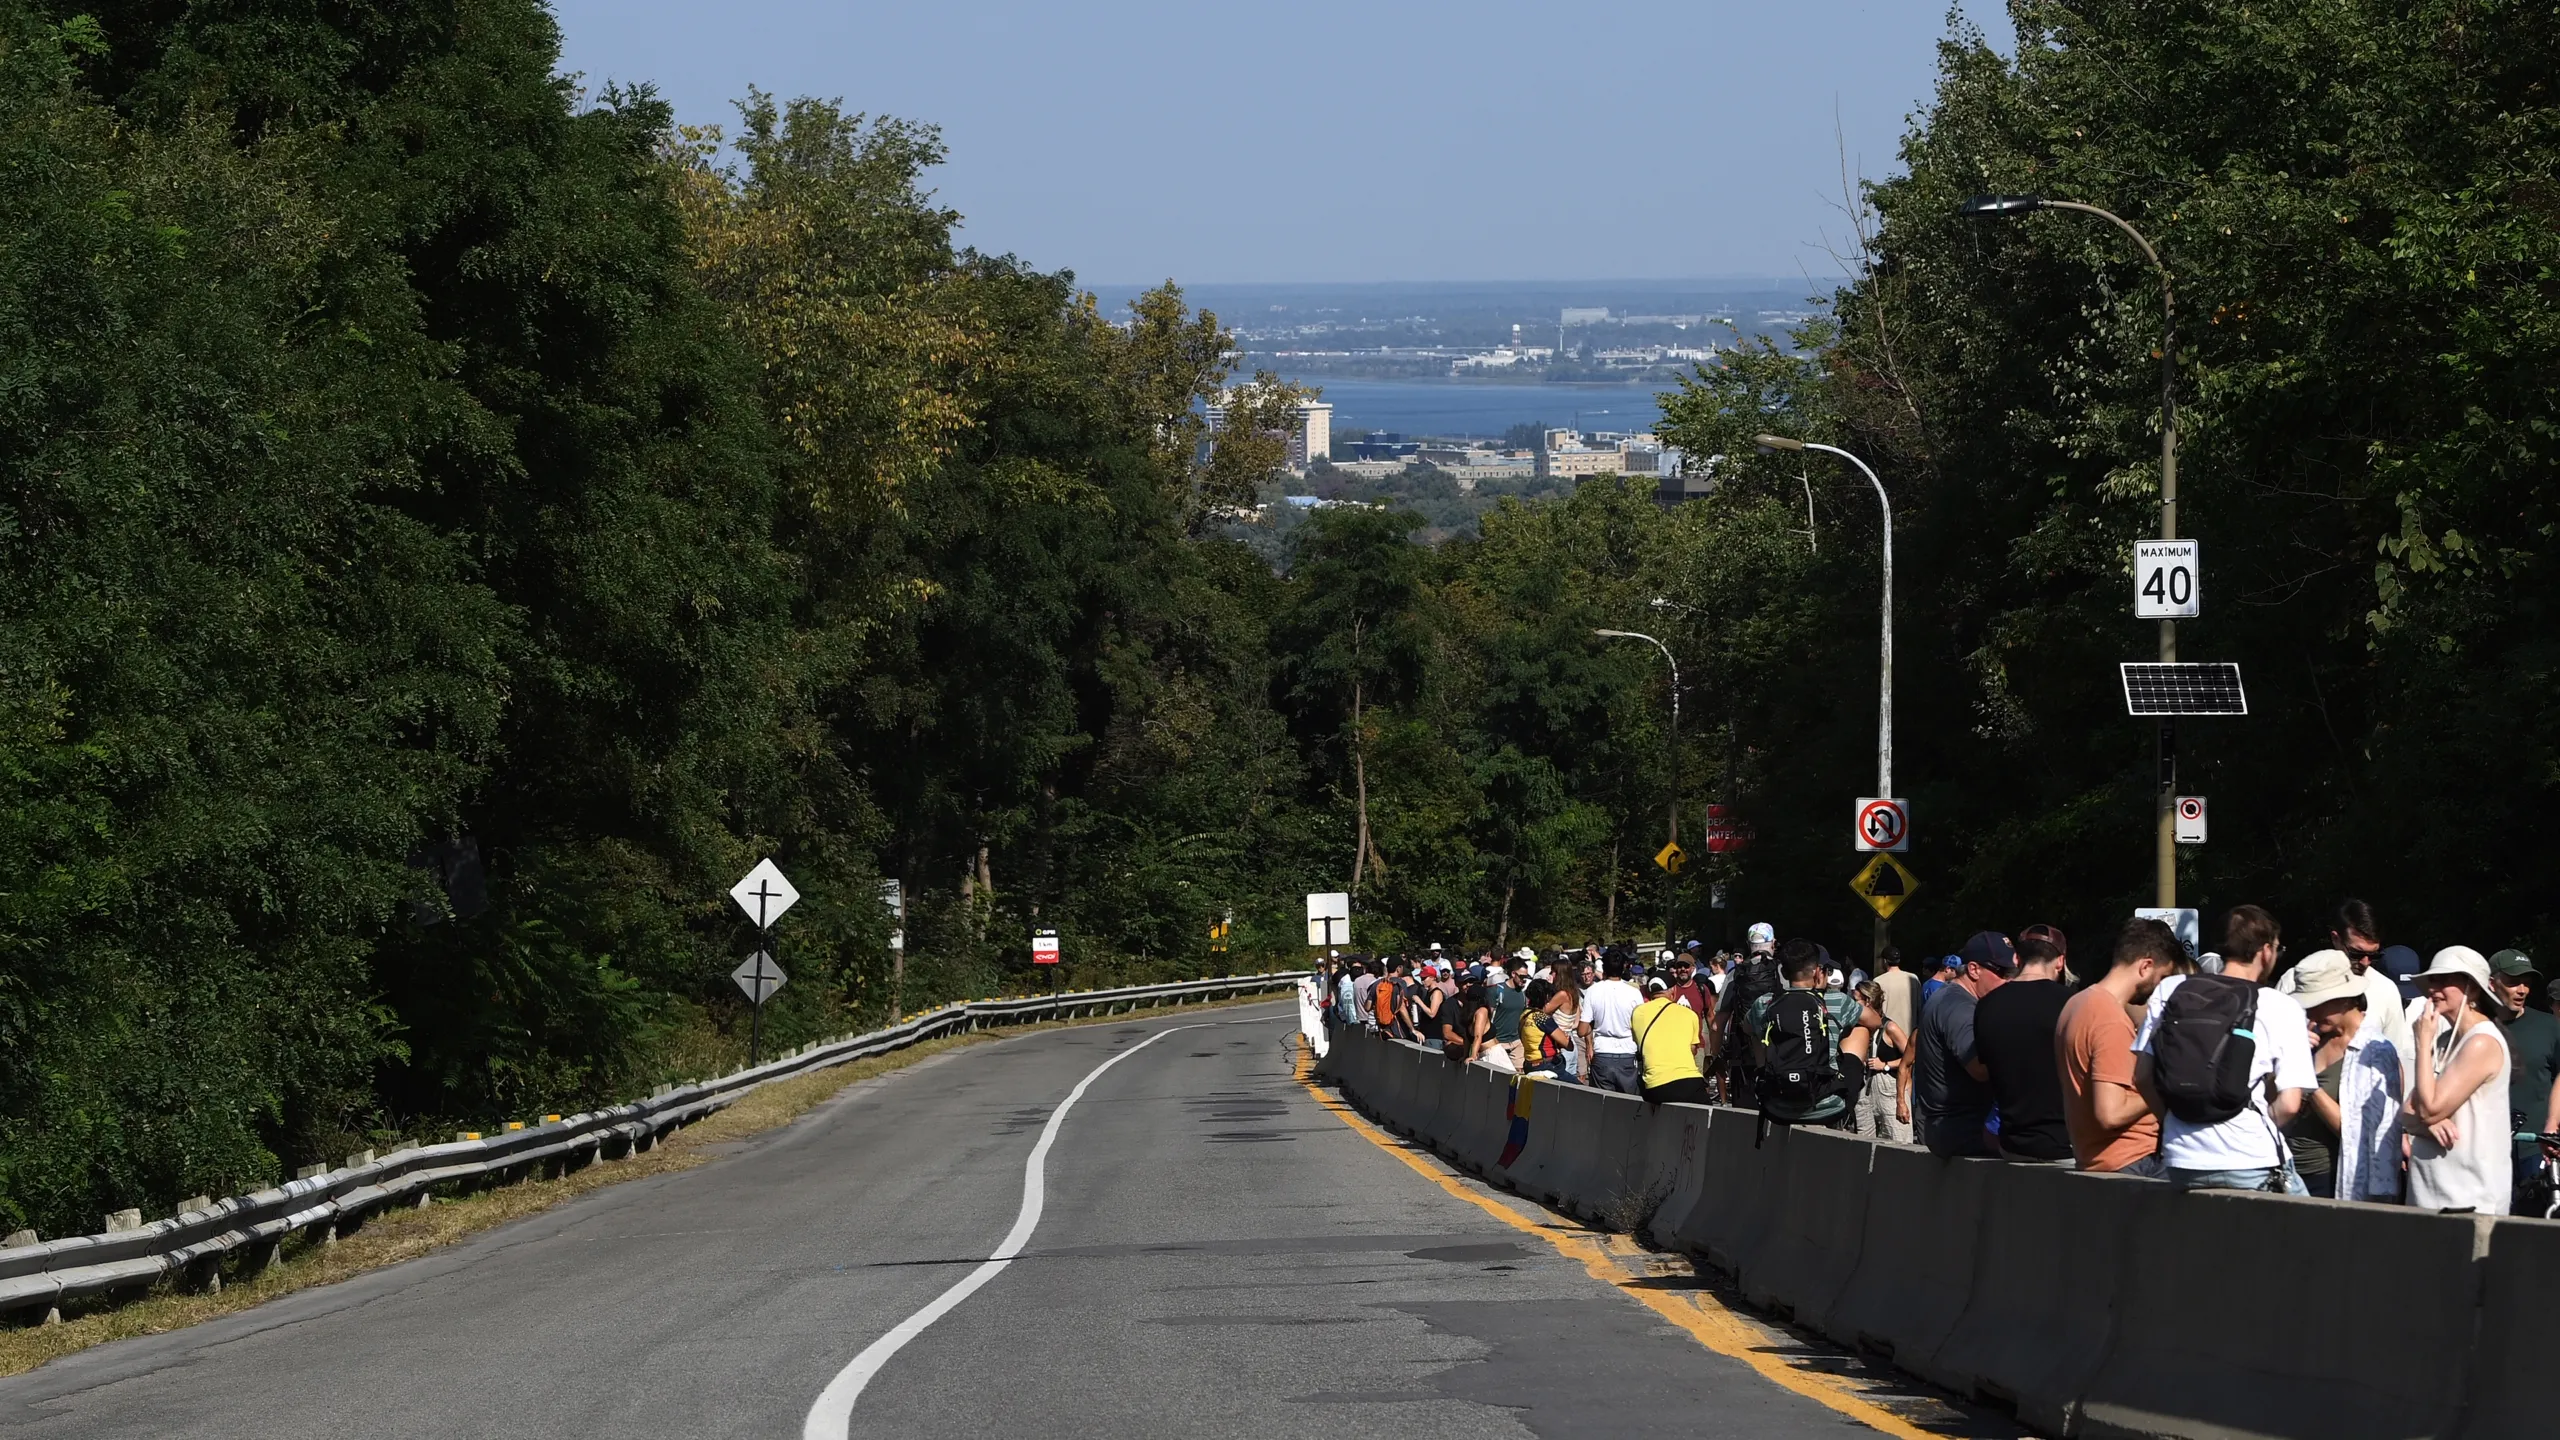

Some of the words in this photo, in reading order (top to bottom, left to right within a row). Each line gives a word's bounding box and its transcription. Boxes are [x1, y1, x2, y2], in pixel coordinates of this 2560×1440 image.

[2140, 547, 2192, 557] MAXIMUM
[2142, 565, 2192, 605] 40
[1802, 1009, 1813, 1055] ORTOVOX
